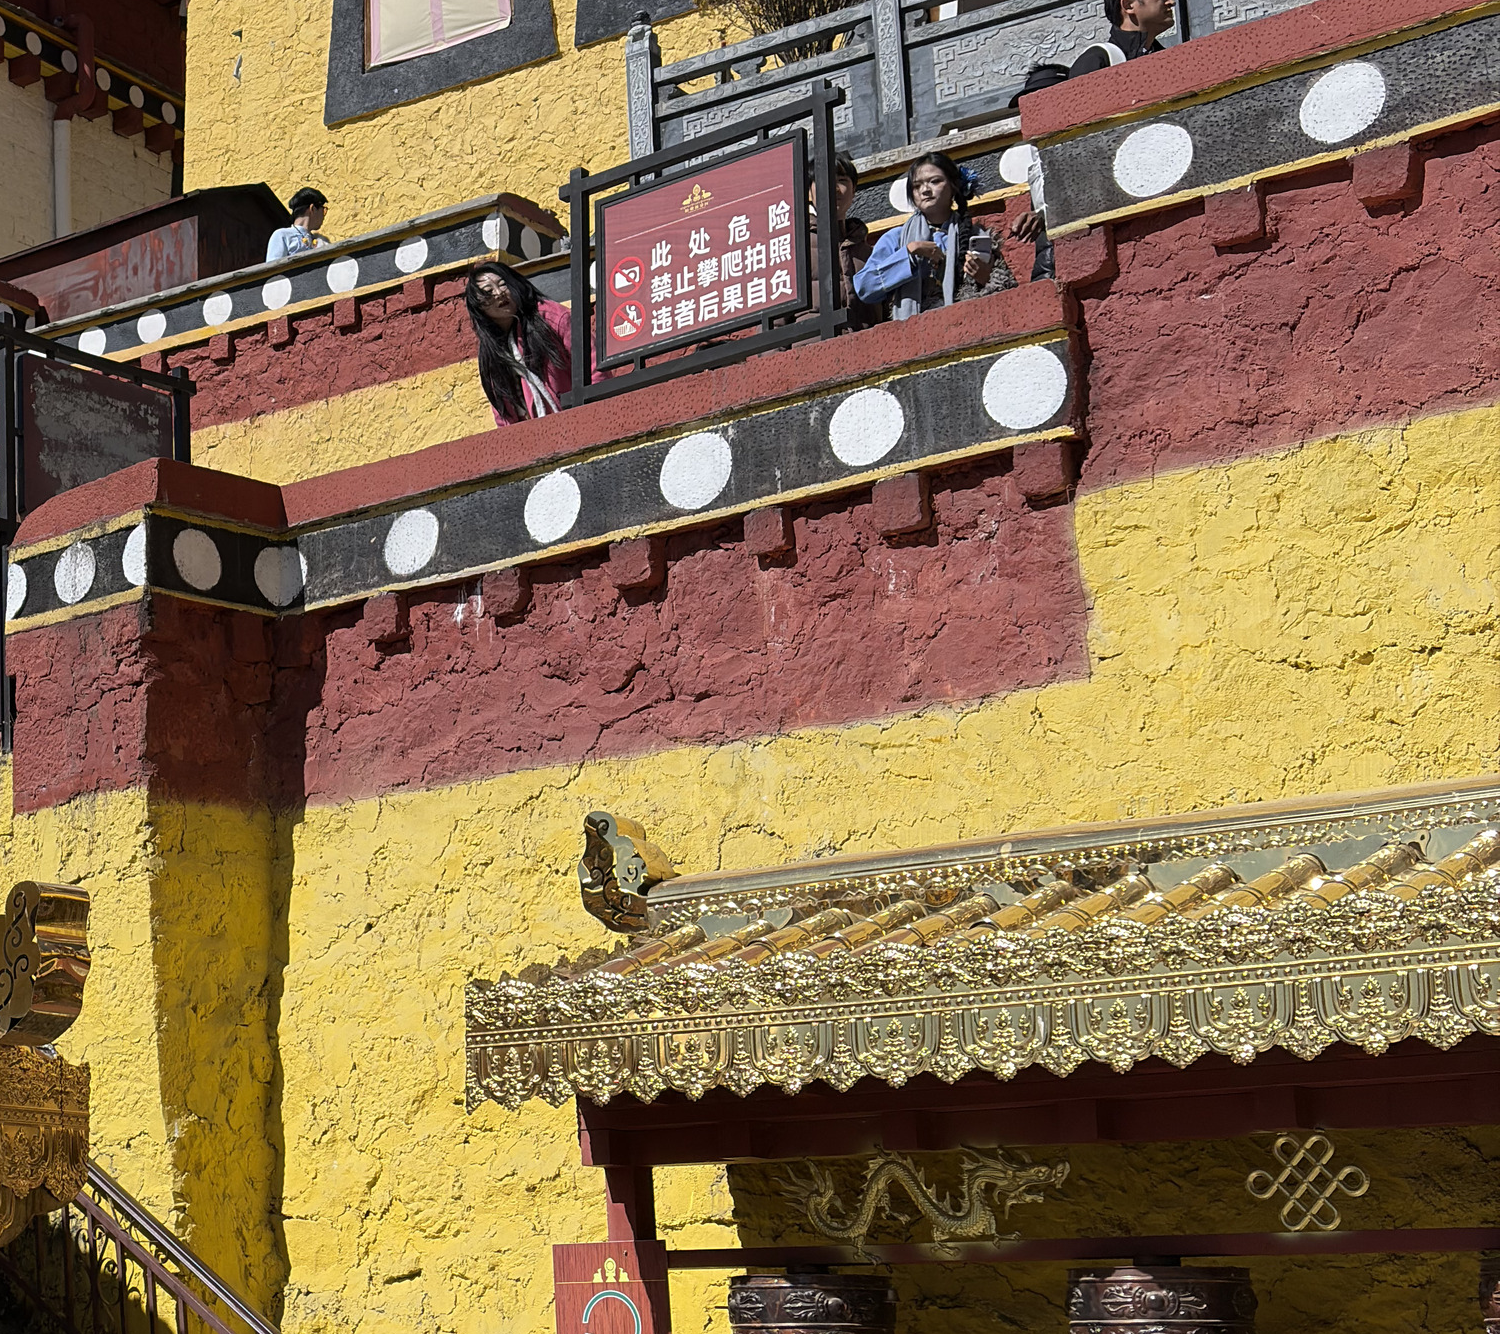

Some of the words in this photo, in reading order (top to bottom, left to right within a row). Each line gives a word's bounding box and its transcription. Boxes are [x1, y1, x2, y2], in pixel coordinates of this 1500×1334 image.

[650, 233, 792, 304] 禁止攀爬拍照
[650, 269, 793, 337] 违者后果自负
